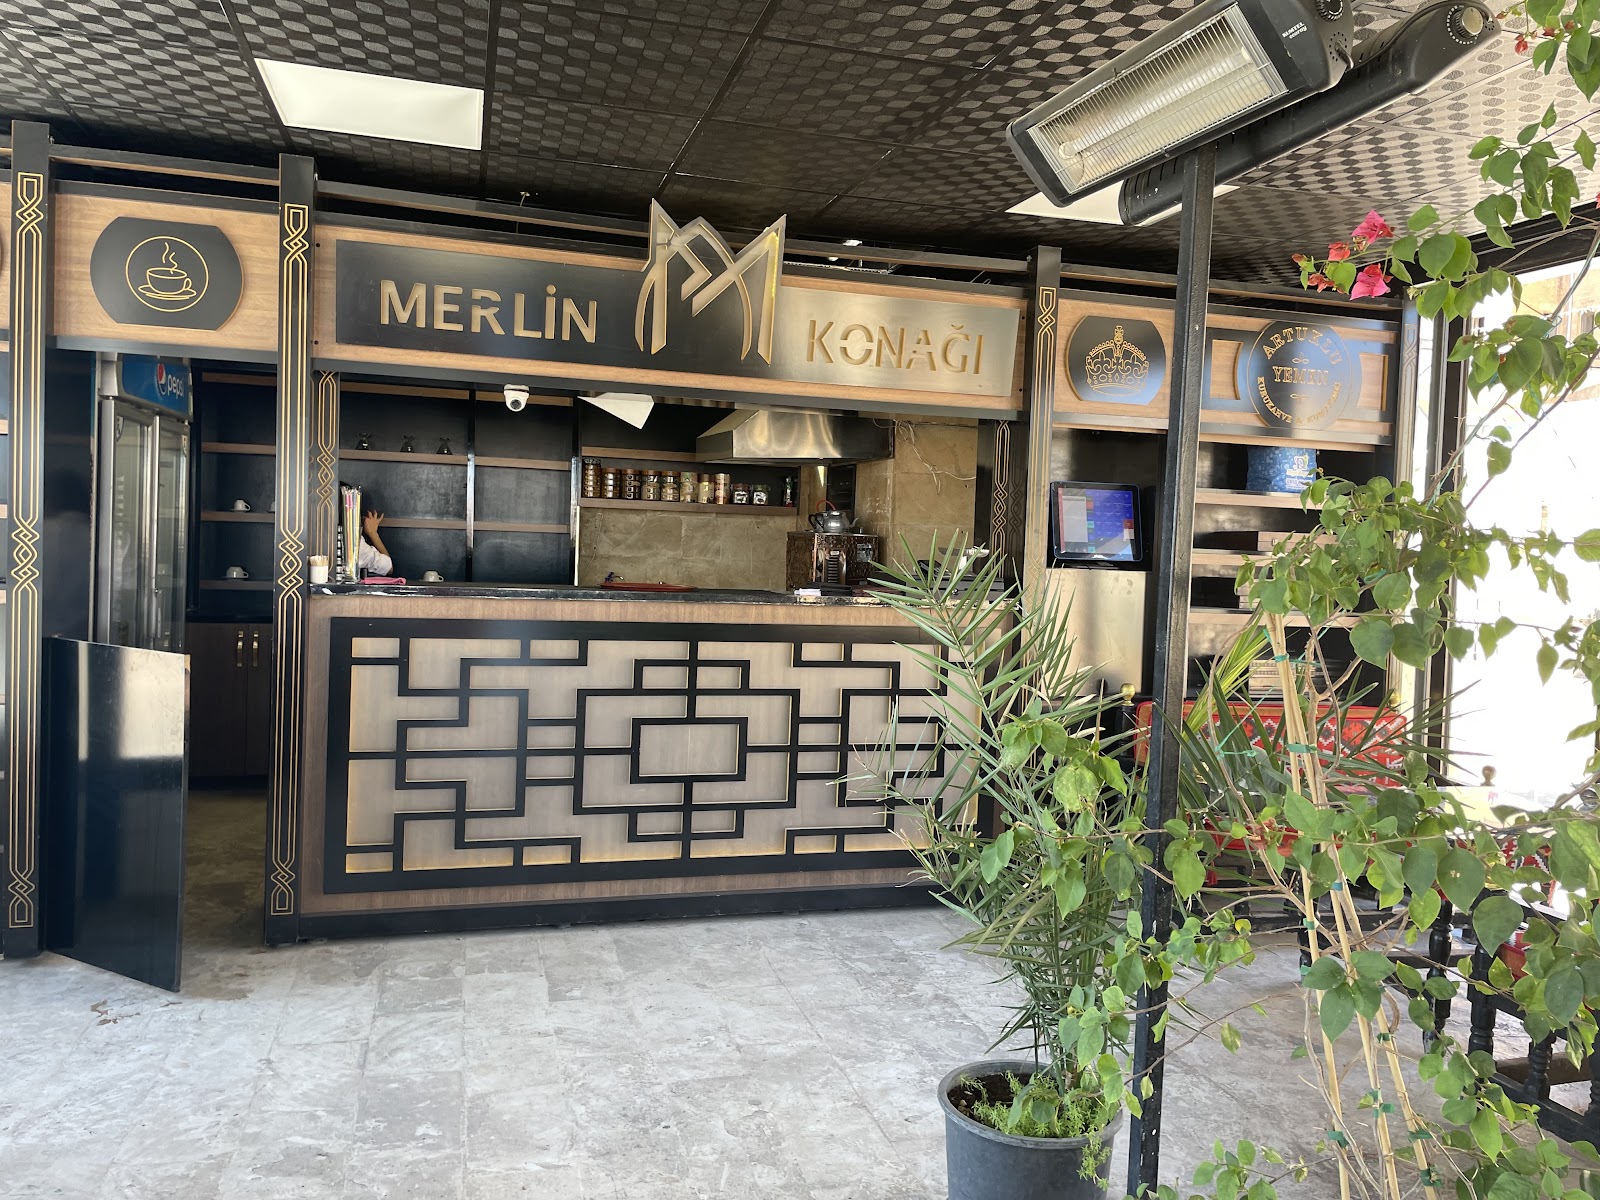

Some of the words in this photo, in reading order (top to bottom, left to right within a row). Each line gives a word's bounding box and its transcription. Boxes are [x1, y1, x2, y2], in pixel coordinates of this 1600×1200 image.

[380, 279, 597, 343] MERLİN
[806, 319, 984, 375] KONAĞI
[1262, 326, 1342, 365] ARTUKLU
[1272, 365, 1329, 385] YEMEN
